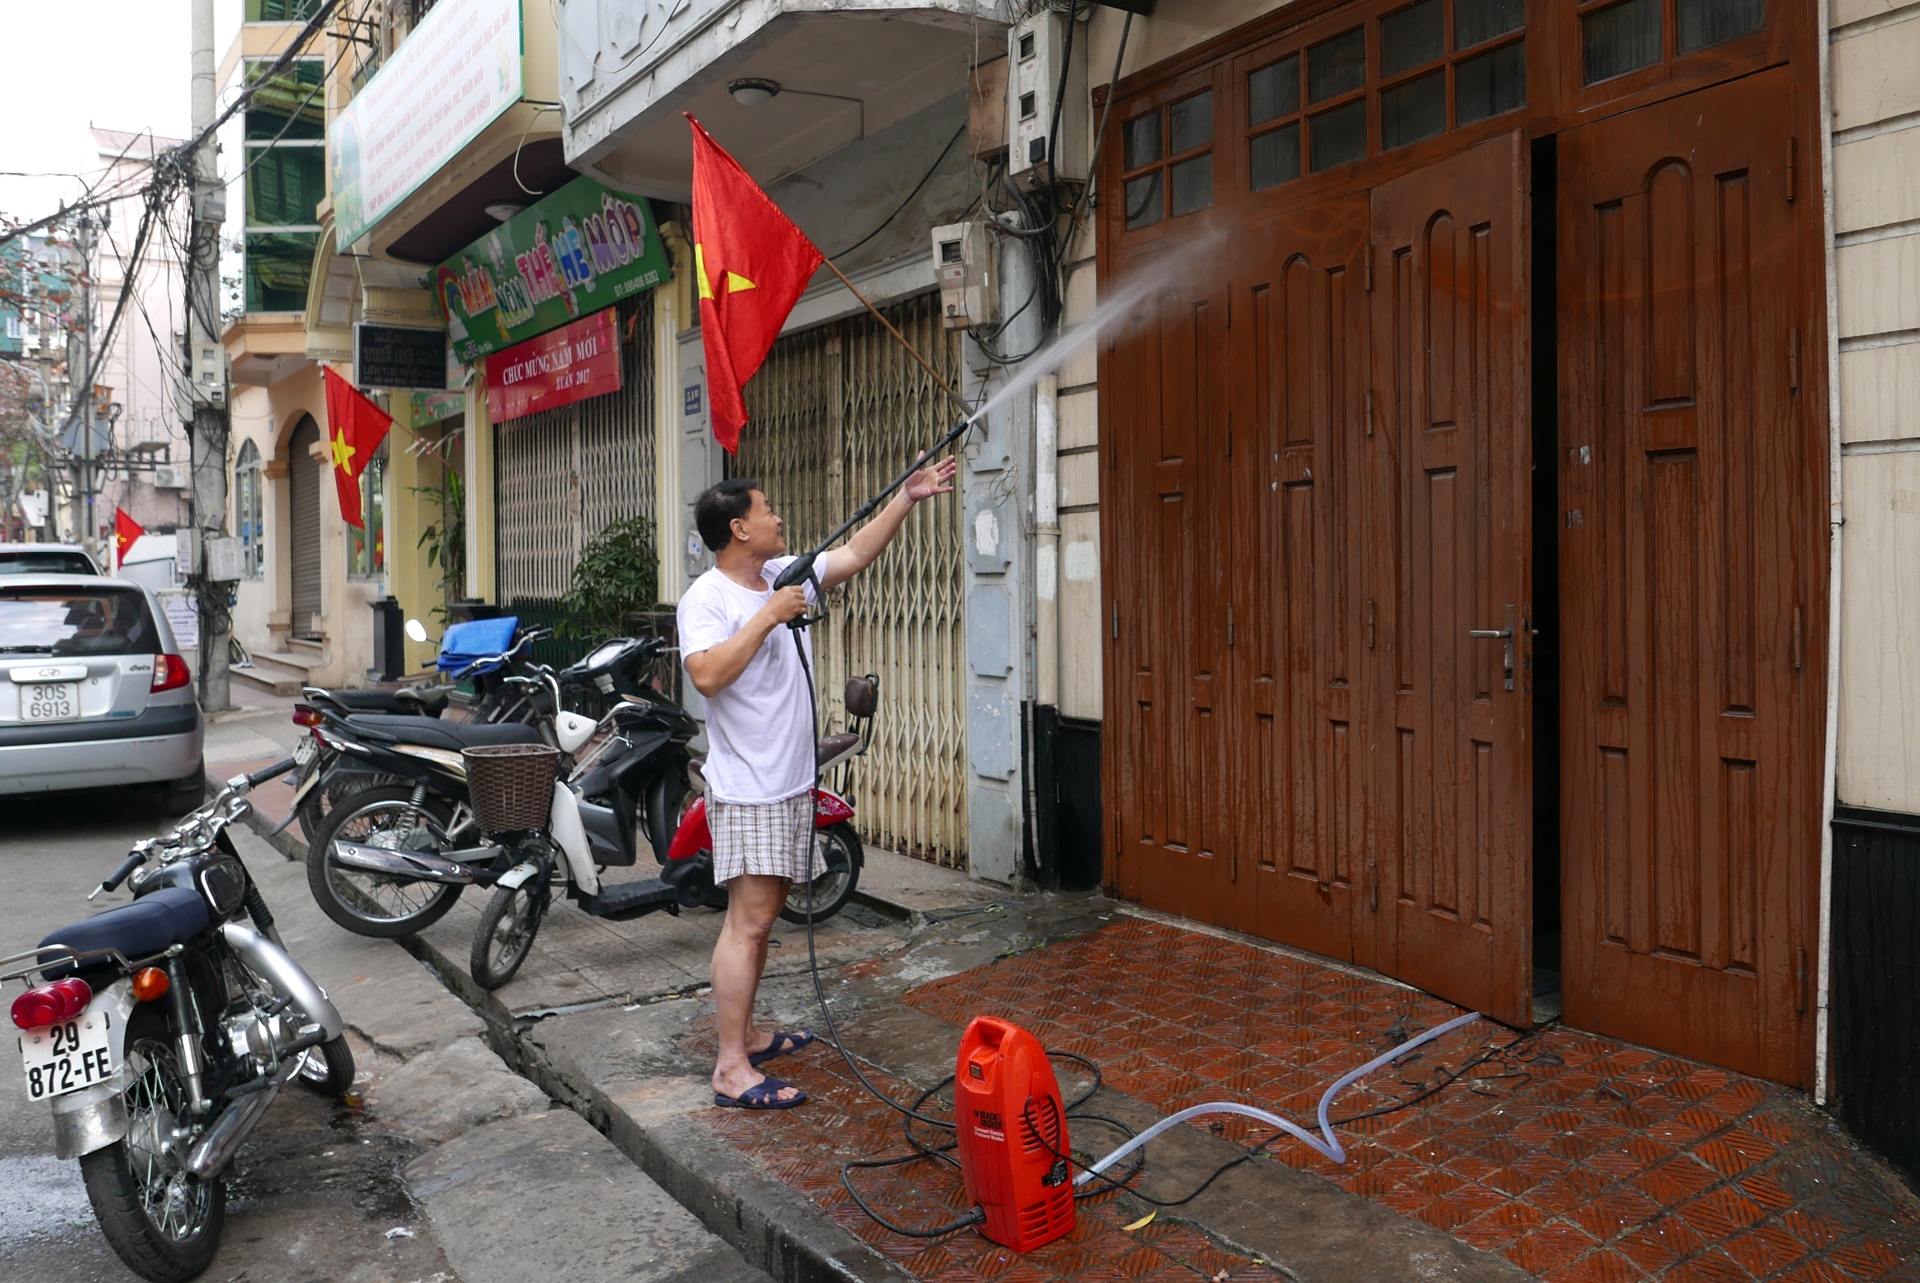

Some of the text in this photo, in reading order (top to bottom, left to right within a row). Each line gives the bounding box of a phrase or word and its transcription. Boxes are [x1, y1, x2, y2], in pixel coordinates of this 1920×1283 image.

[515, 222, 560, 305] THẾ
[552, 216, 591, 292] HỆ
[494, 276, 535, 329] NON
[503, 357, 525, 386] CHÚC
[524, 351, 550, 379] MỪNG
[576, 330, 598, 362] MỚI
[576, 368, 590, 385] 2017
[31, 701, 70, 717] 6913
[33, 685, 66, 701] 30S
[50, 1021, 80, 1056] 29
[29, 1047, 112, 1098] 872-FE
